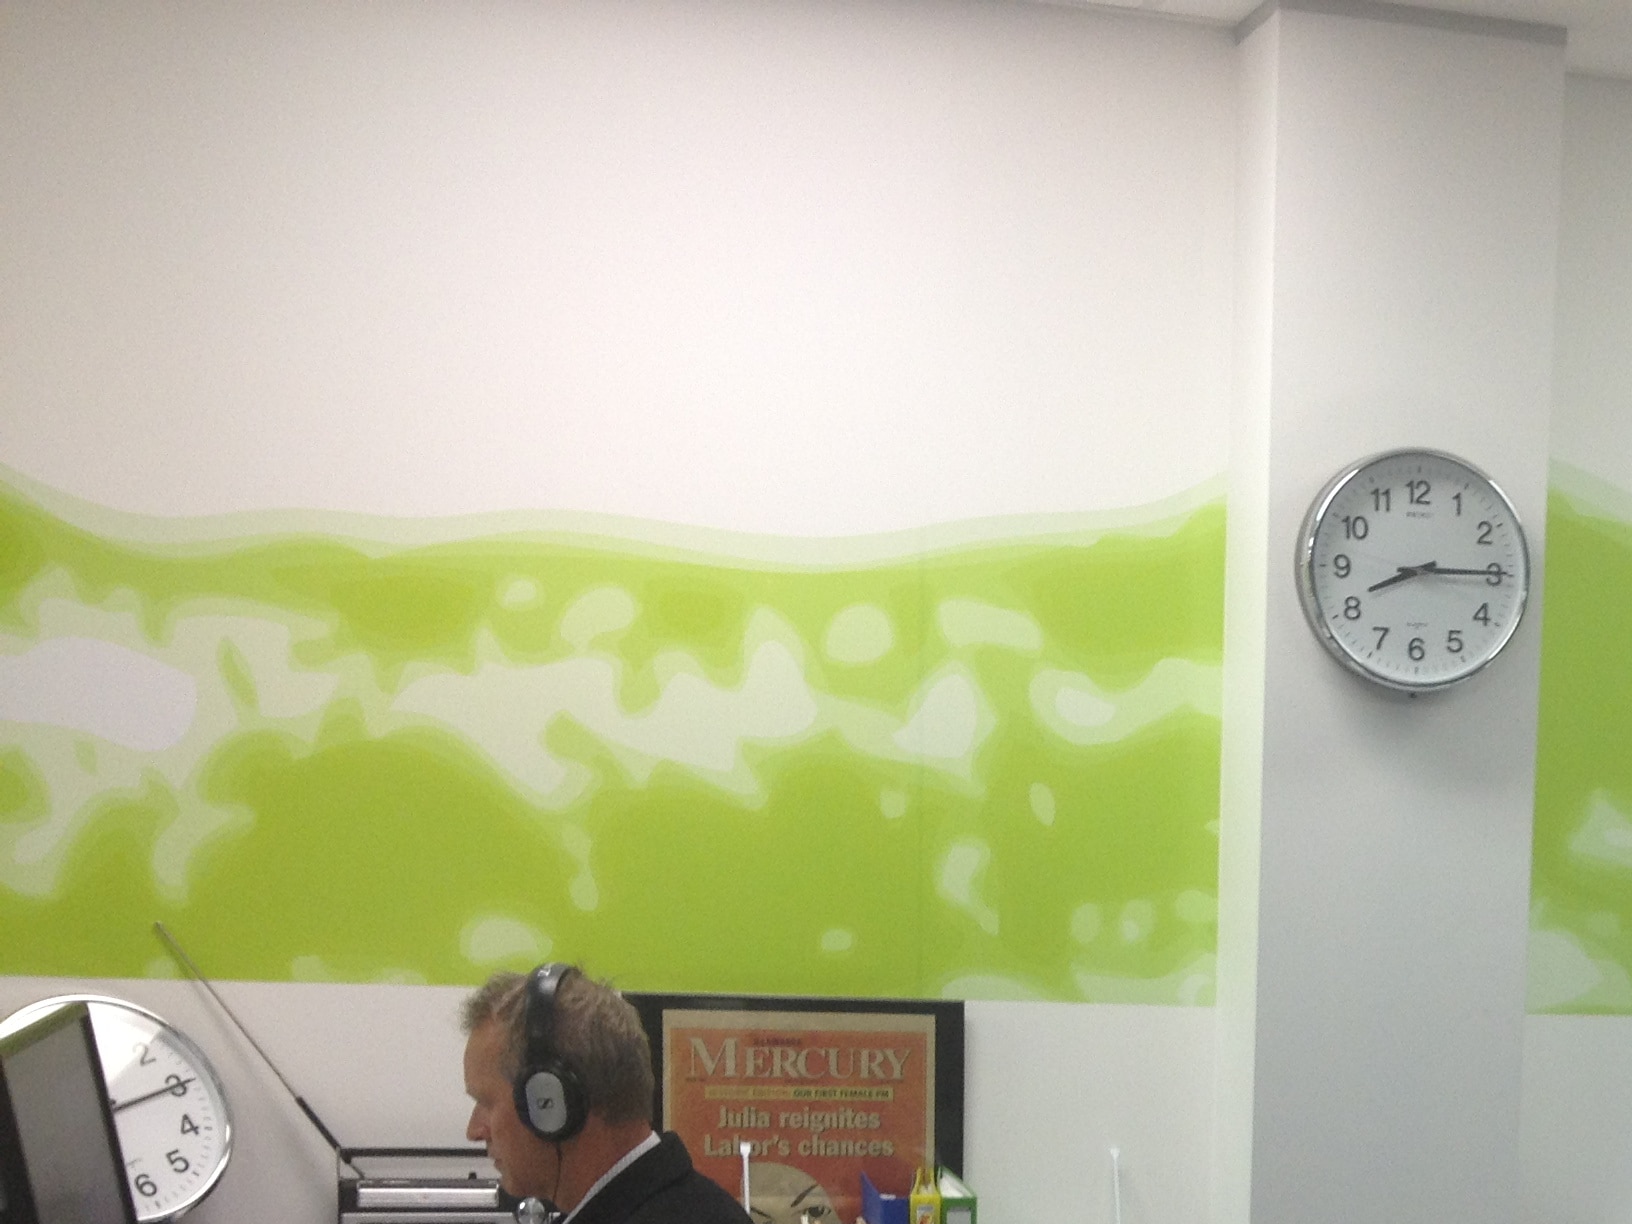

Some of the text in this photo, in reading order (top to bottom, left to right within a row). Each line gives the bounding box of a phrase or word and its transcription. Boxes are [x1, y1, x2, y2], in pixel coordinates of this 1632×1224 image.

[1370, 488, 1391, 512] 11
[1405, 480, 1431, 505] 12
[1452, 492, 1462, 516] 1
[1341, 515, 1369, 540] 10
[1476, 521, 1494, 545] 2
[1333, 554, 1351, 579] 9
[1485, 563, 1503, 587] 3
[1344, 596, 1362, 621] 8
[1472, 602, 1491, 626] 4
[1372, 626, 1390, 650] 7
[1407, 637, 1425, 661] 6
[1446, 629, 1463, 653] 5
[132, 1041, 157, 1067] 2
[689, 1037, 913, 1081] MERCURY
[165, 1074, 187, 1097] 3
[180, 1113, 200, 1136] 4
[718, 1104, 881, 1132] Julia reignites
[798, 1133, 894, 1158] chances
[166, 1149, 190, 1173] 5
[134, 1173, 157, 1197] 6
